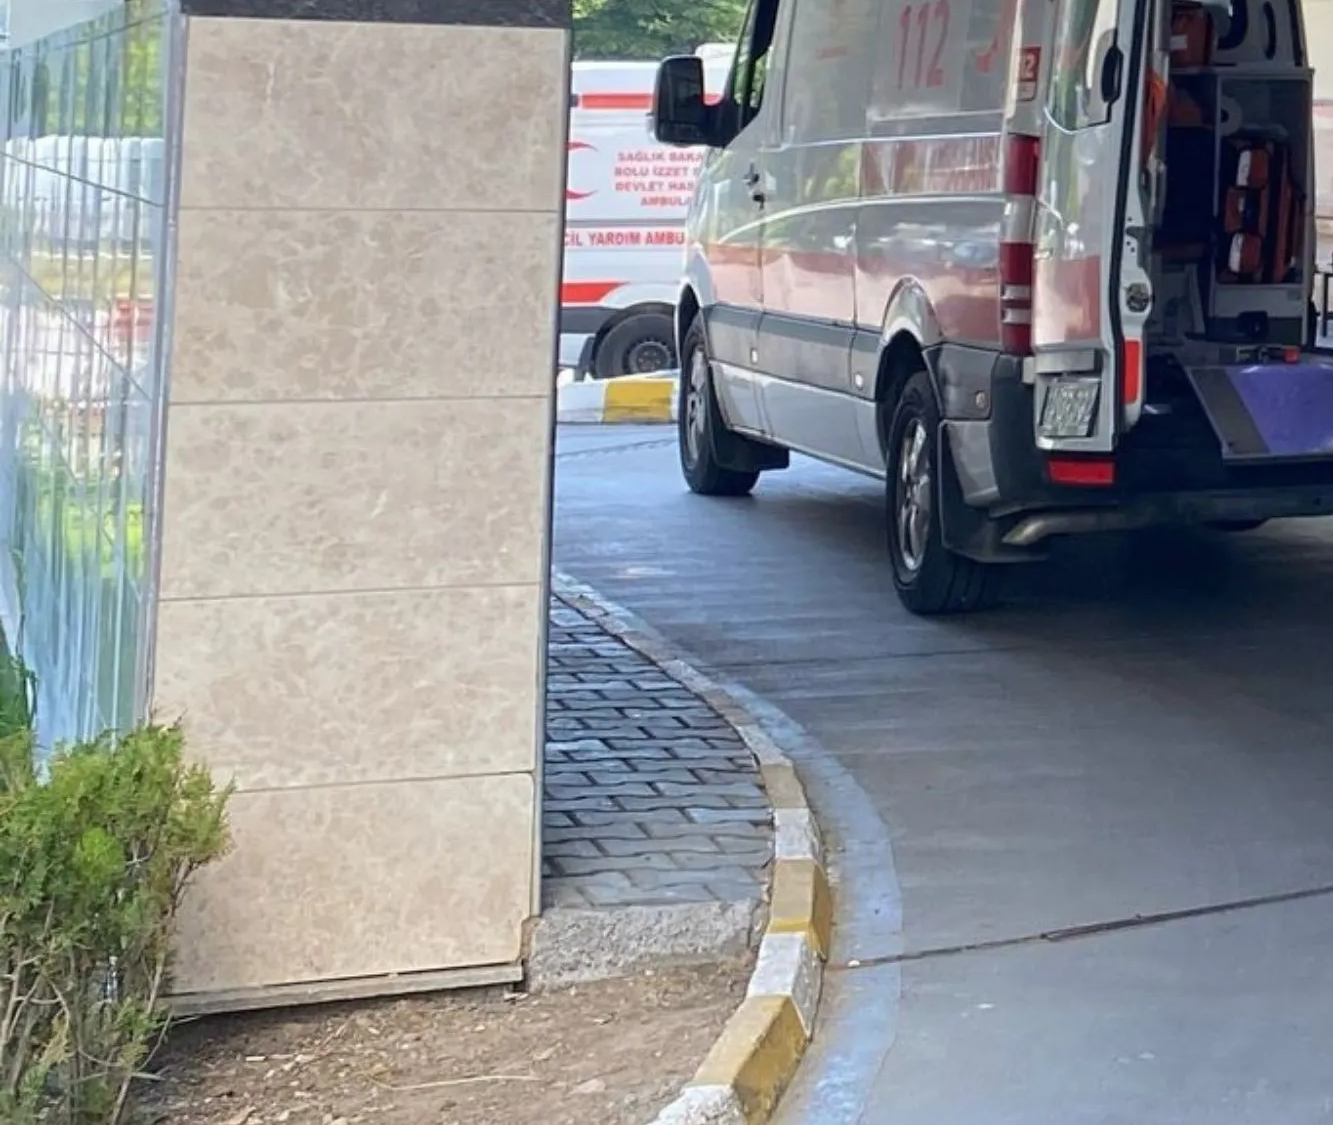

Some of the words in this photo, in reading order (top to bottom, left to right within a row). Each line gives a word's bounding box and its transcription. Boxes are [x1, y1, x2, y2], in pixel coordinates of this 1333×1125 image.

[617, 150, 665, 162] SAĞLIK
[614, 166, 649, 176] BOLU
[615, 181, 665, 192] DEVLET
[588, 231, 641, 246] YARDIM
